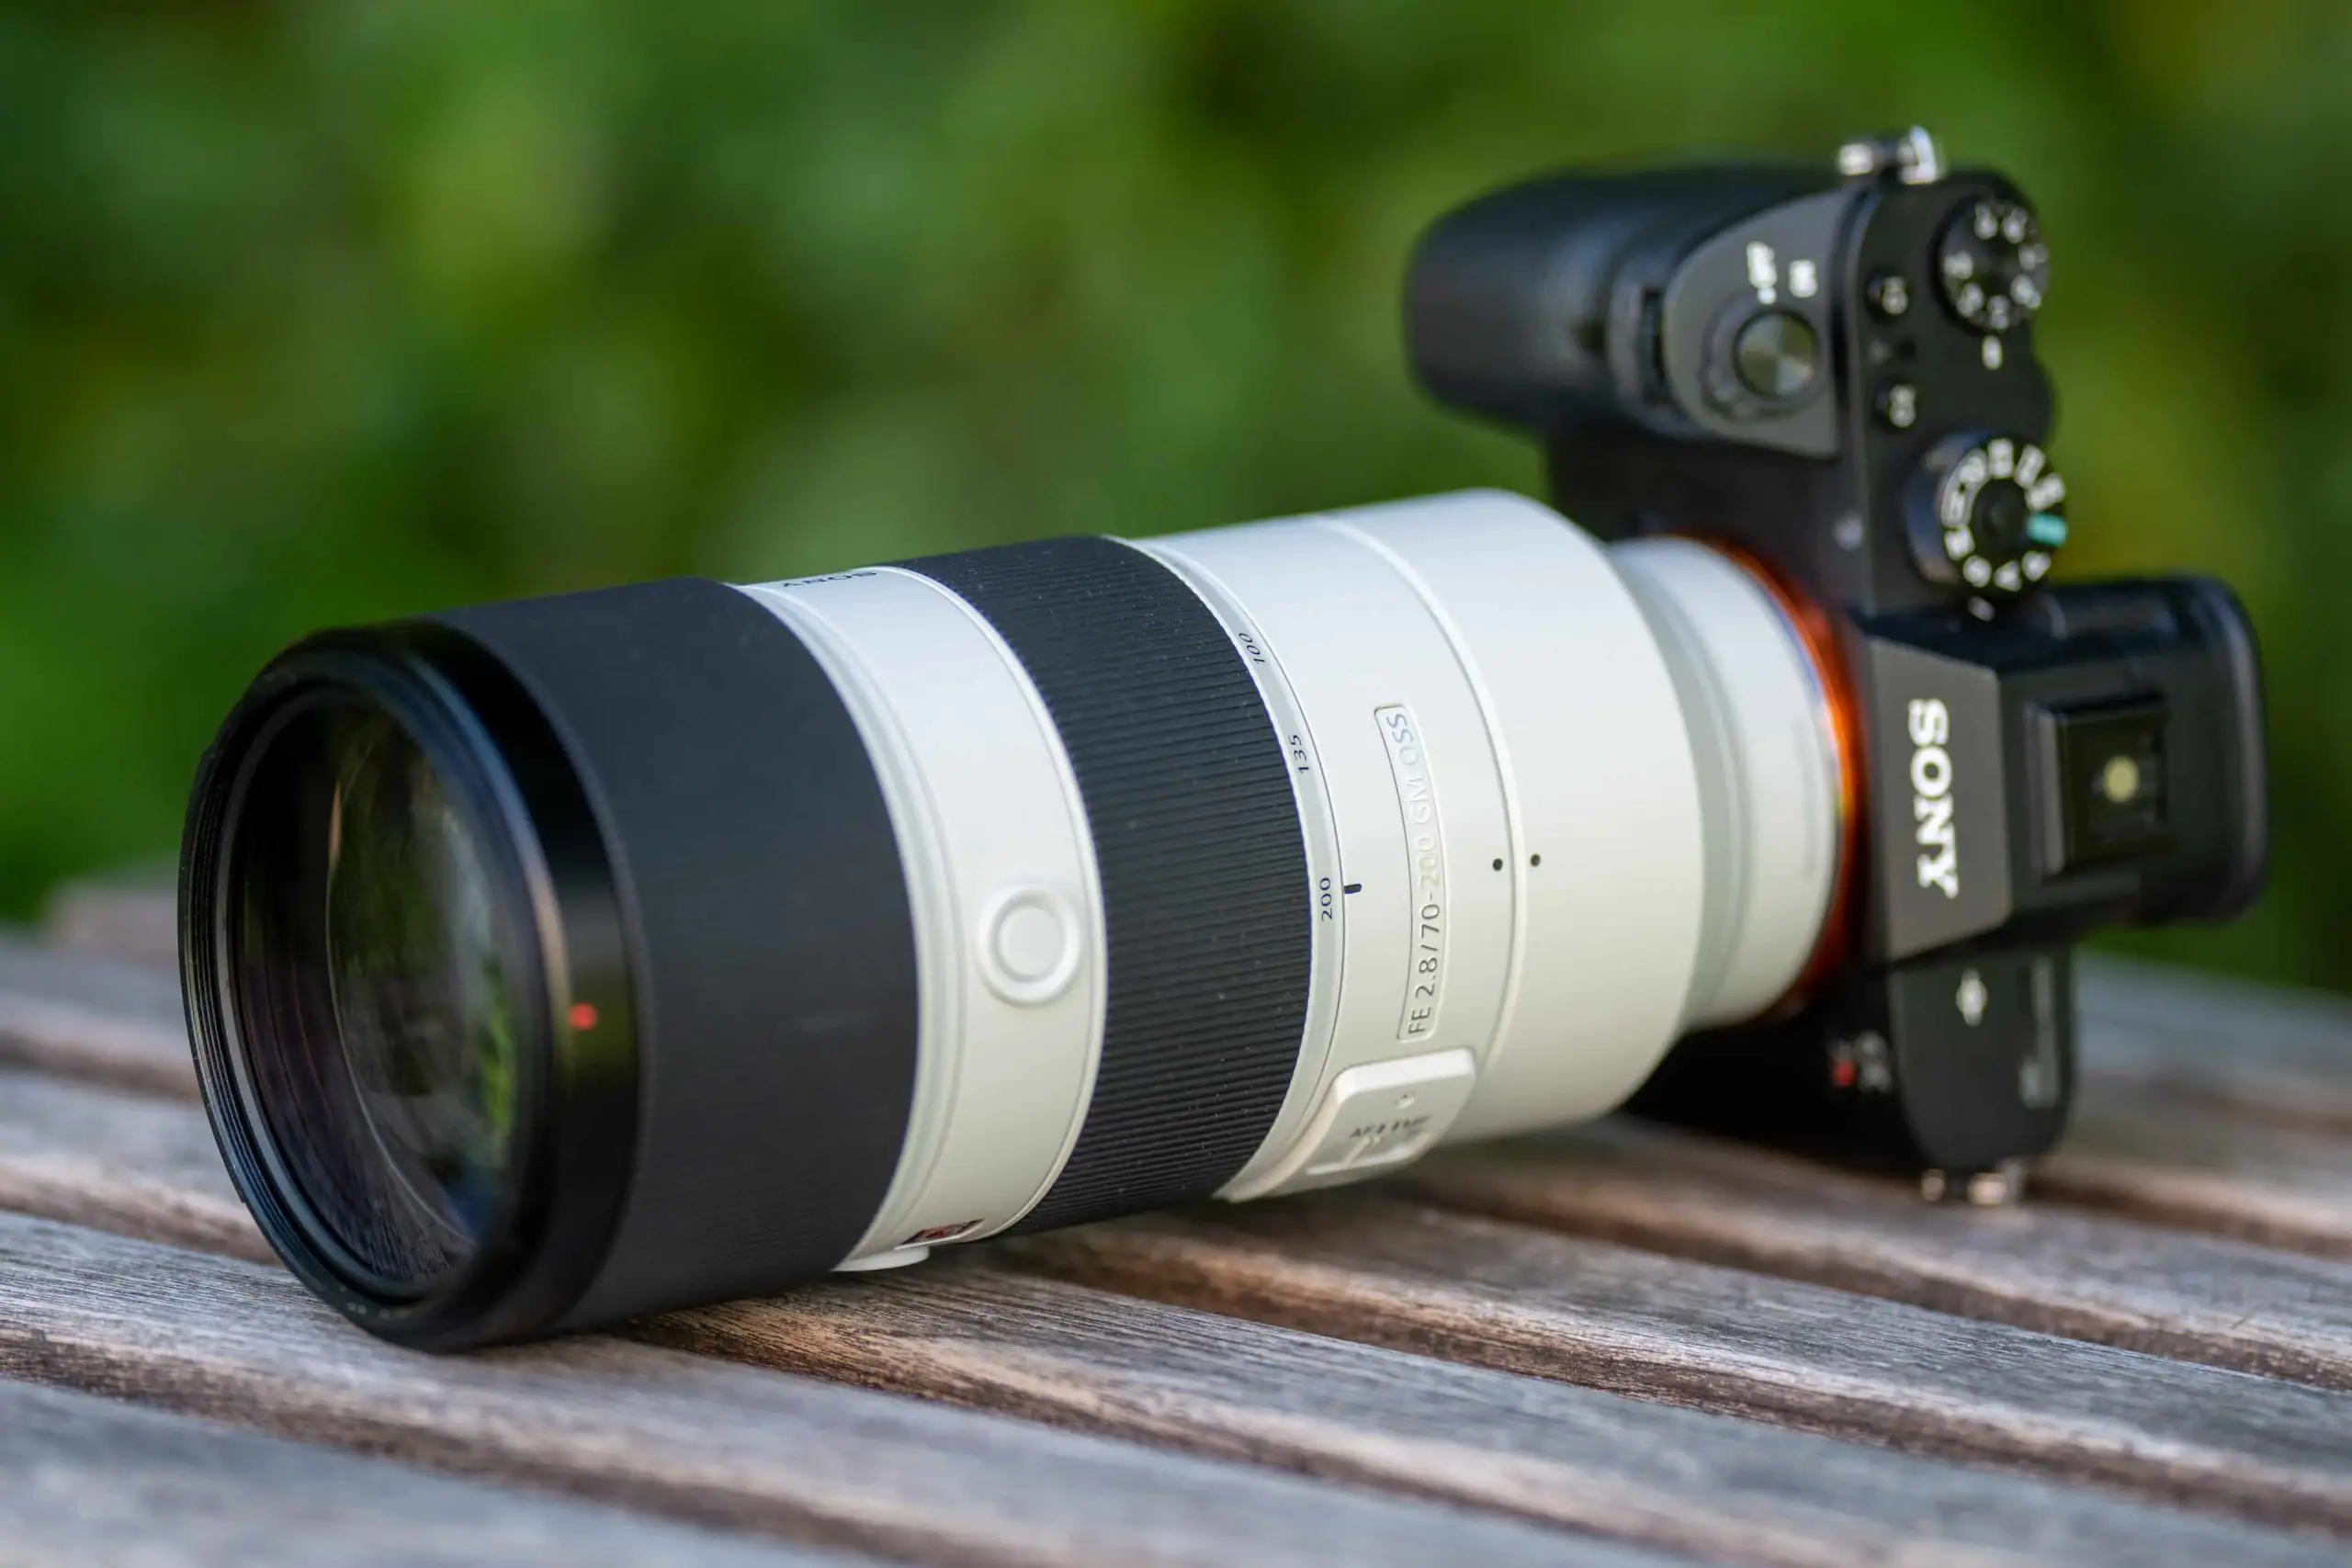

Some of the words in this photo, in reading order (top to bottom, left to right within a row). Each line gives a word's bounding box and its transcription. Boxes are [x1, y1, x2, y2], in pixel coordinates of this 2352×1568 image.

[1238, 631, 1265, 664] 100
[1287, 733, 1310, 774] 135
[1385, 712, 1420, 767] OSS
[1406, 776, 1432, 827] GM
[1907, 697, 1960, 899] SONY
[1319, 876, 1334, 922] 200
[1415, 836, 1442, 997] 2.8/70-200
[1408, 1006, 1432, 1034] FE
